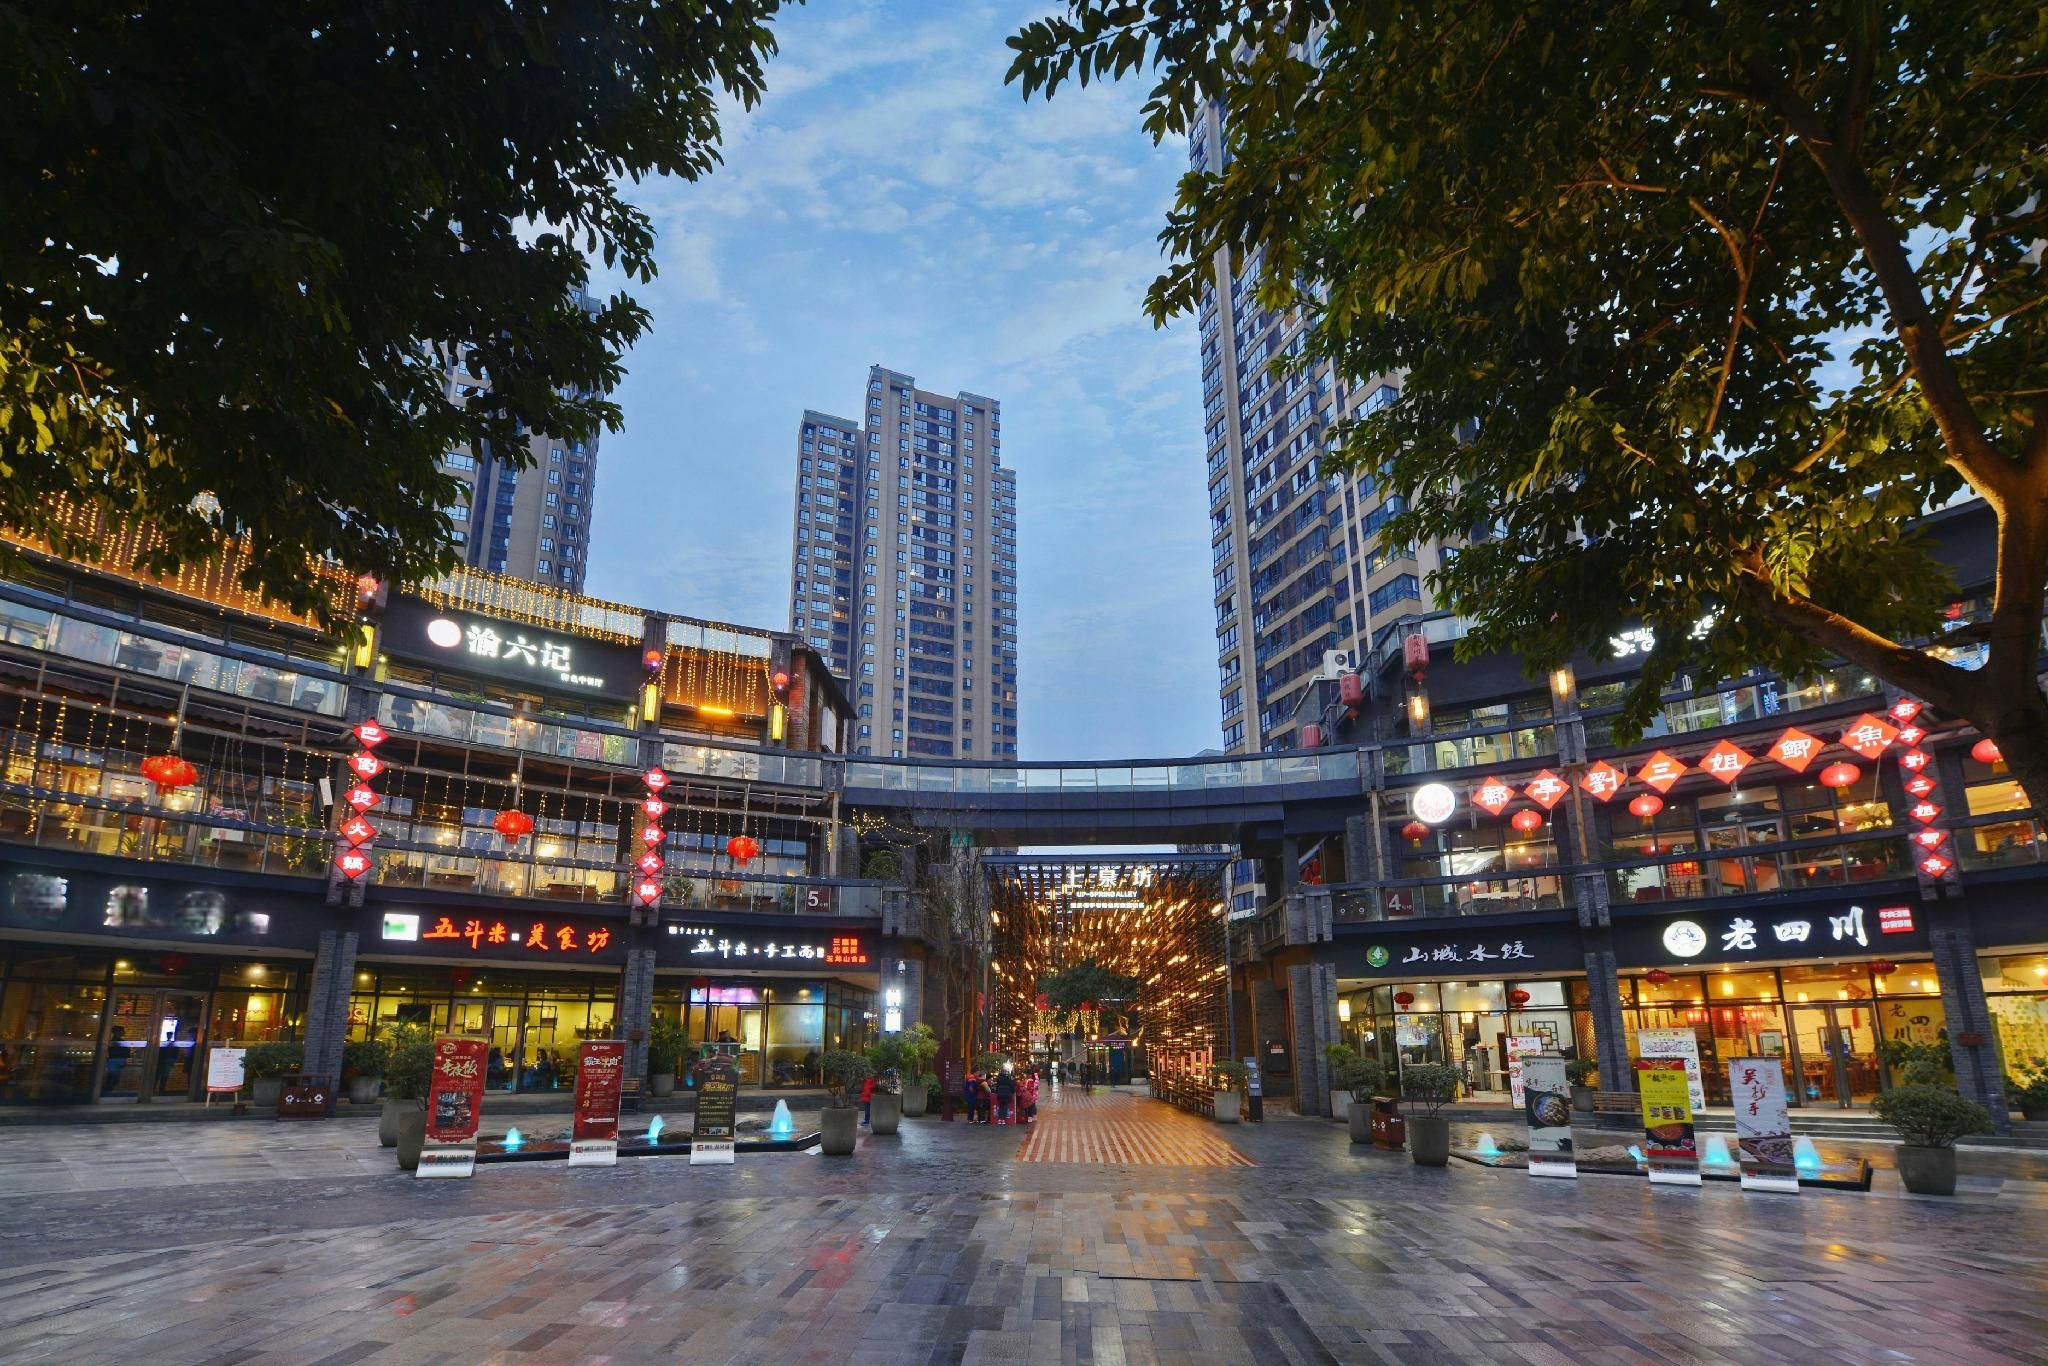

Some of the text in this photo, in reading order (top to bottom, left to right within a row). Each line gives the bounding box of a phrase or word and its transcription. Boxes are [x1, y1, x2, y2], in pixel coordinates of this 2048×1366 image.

[466, 625, 571, 672] 渝六记
[807, 890, 819, 907] 5
[1388, 893, 1402, 911] 4
[1721, 905, 1869, 951] 老四川
